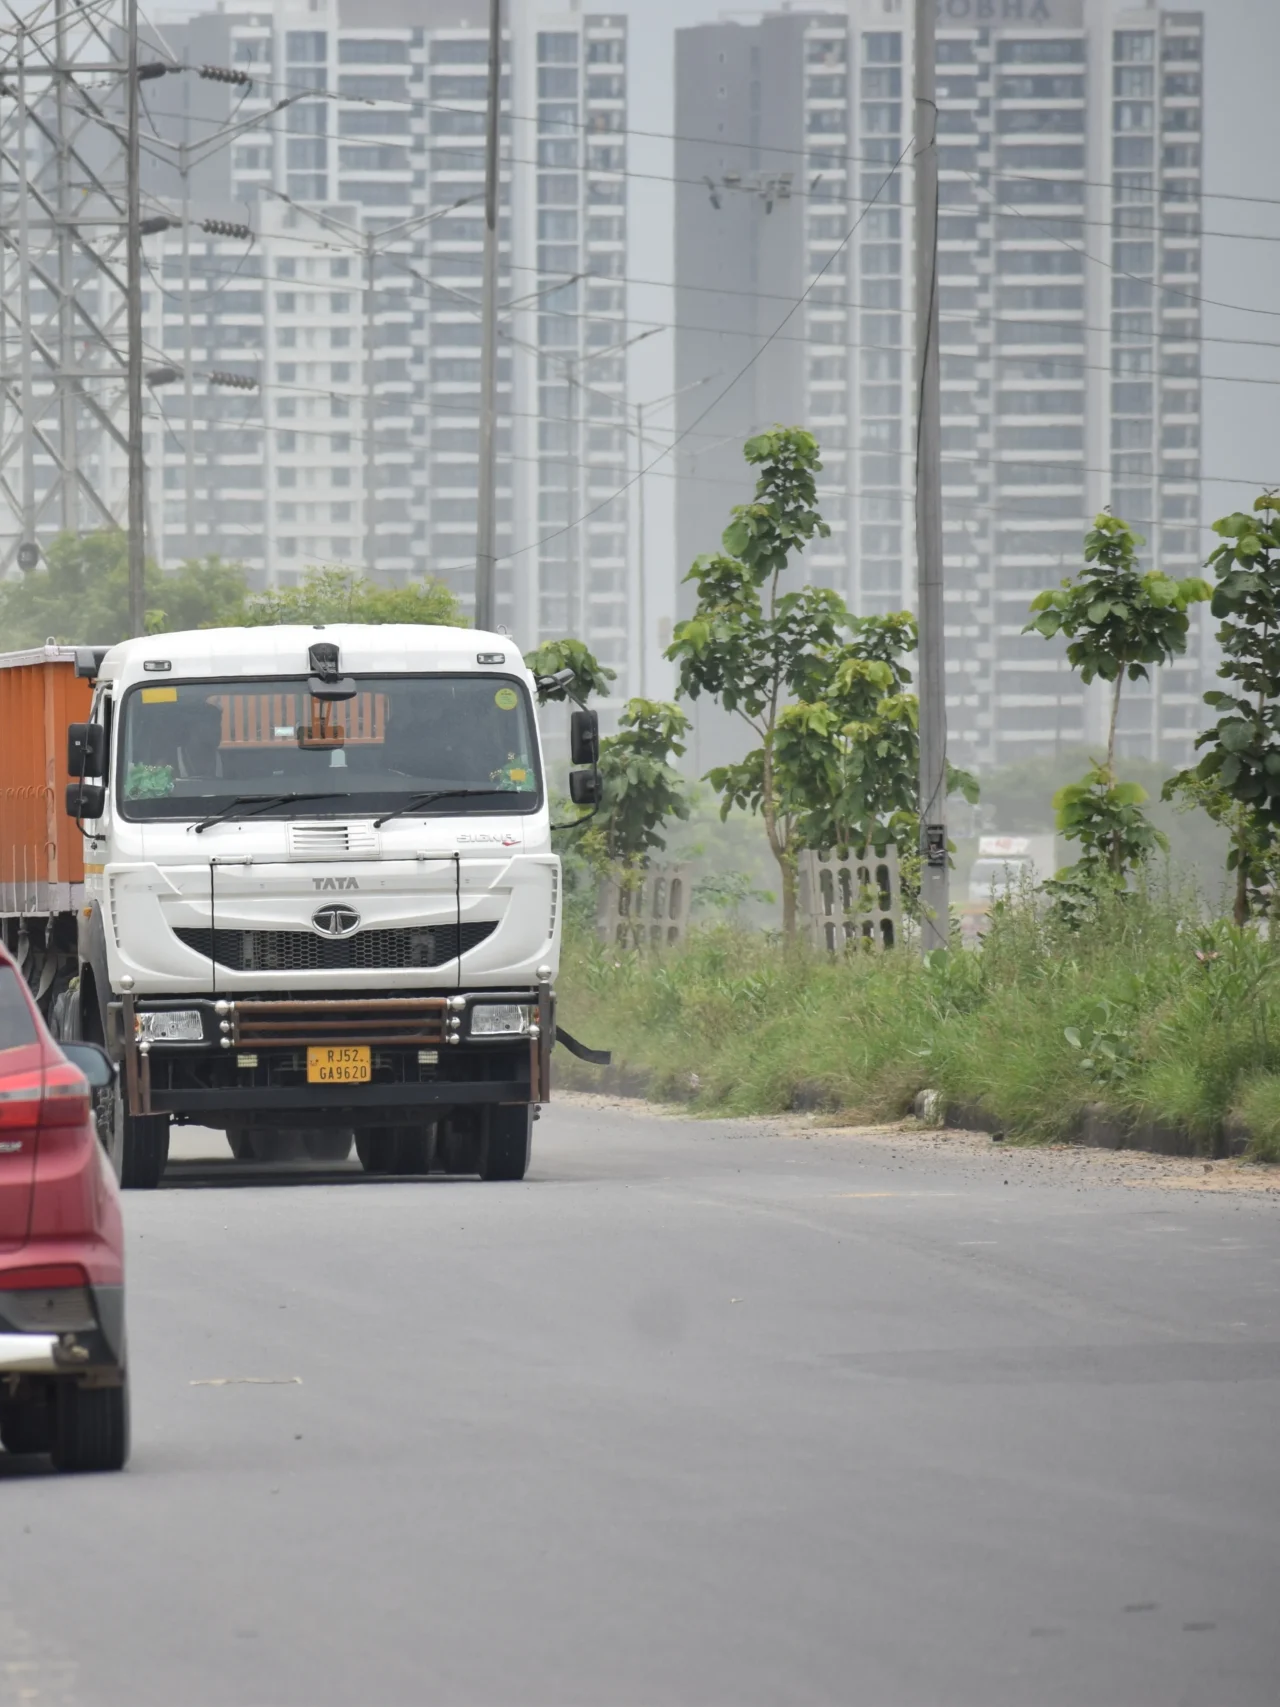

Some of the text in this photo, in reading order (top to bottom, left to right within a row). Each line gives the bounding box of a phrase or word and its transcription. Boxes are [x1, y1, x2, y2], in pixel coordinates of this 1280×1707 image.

[936, 0, 1052, 20] OBHA
[312, 876, 360, 890] TATA
[327, 1049, 359, 1062] RJ52
[320, 1066, 367, 1080] GA9620
